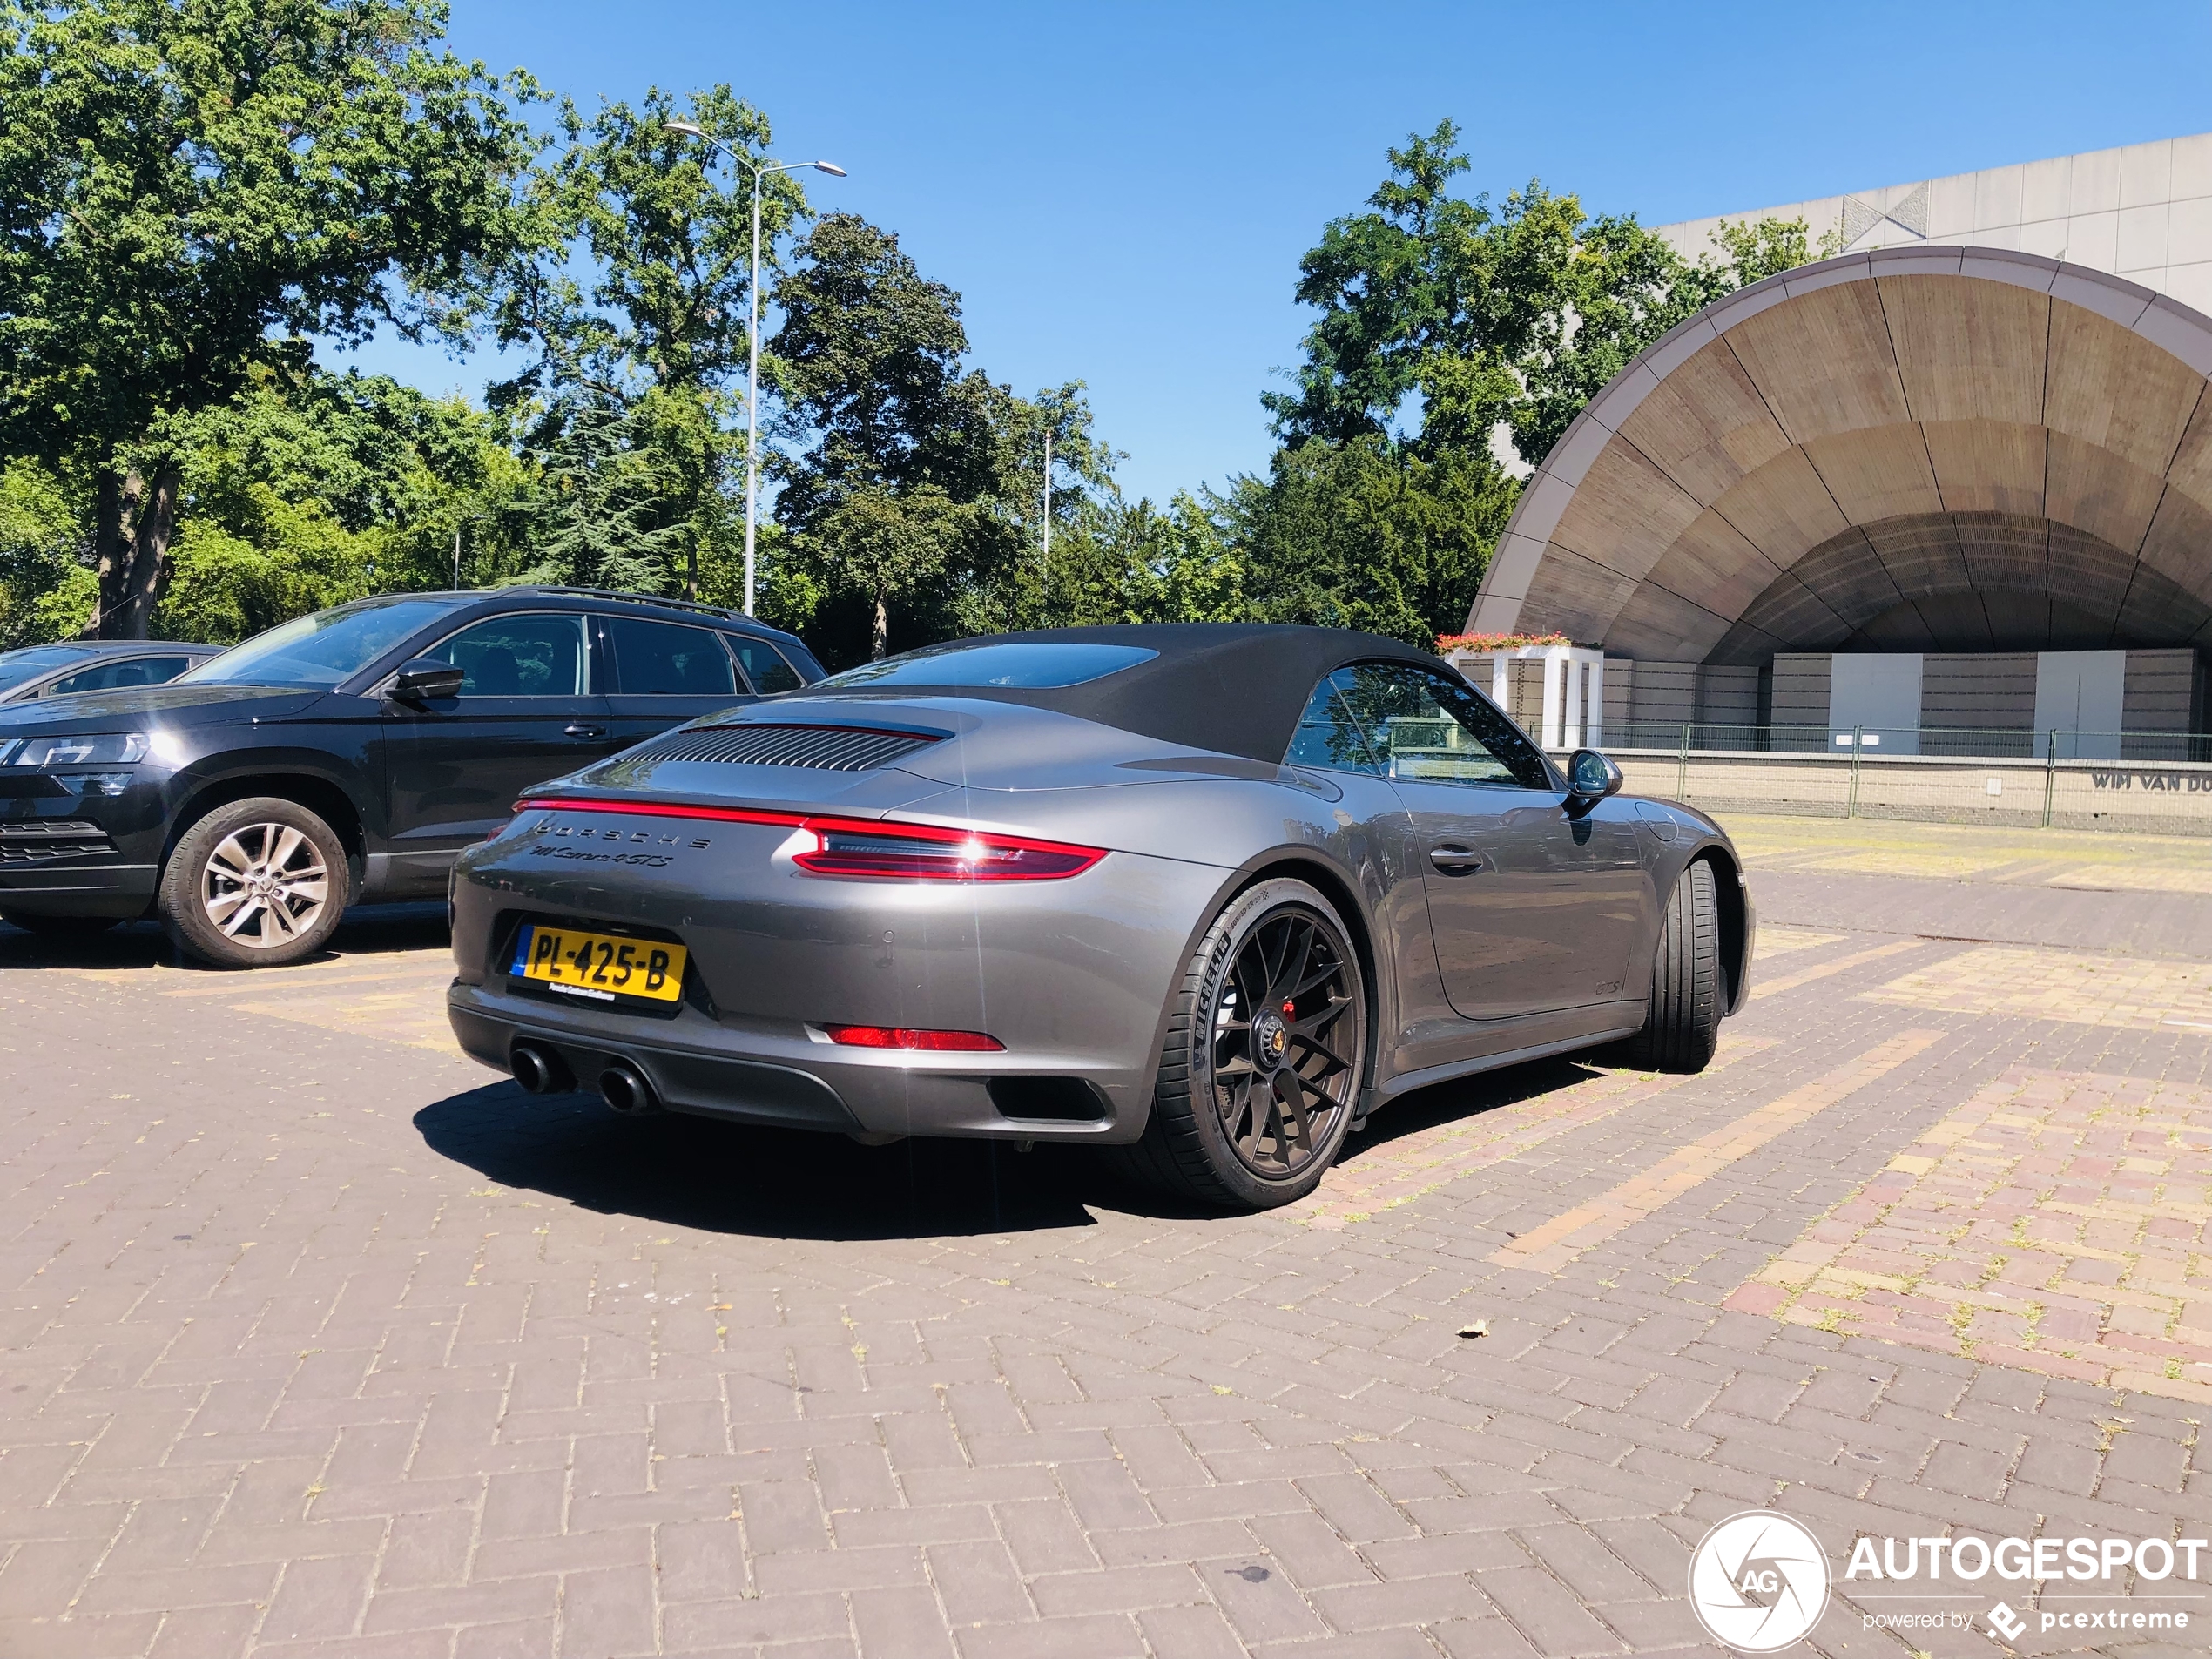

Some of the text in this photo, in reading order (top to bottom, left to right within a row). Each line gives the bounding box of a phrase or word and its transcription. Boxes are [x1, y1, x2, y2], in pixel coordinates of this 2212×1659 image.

[2092, 772, 2132, 790] WIM
[2140, 773, 2181, 792] VAN
[533, 819, 712, 850] PORSCHE
[532, 934, 670, 992] PL-425-B
[1195, 934, 1230, 1040] MICHELIN
